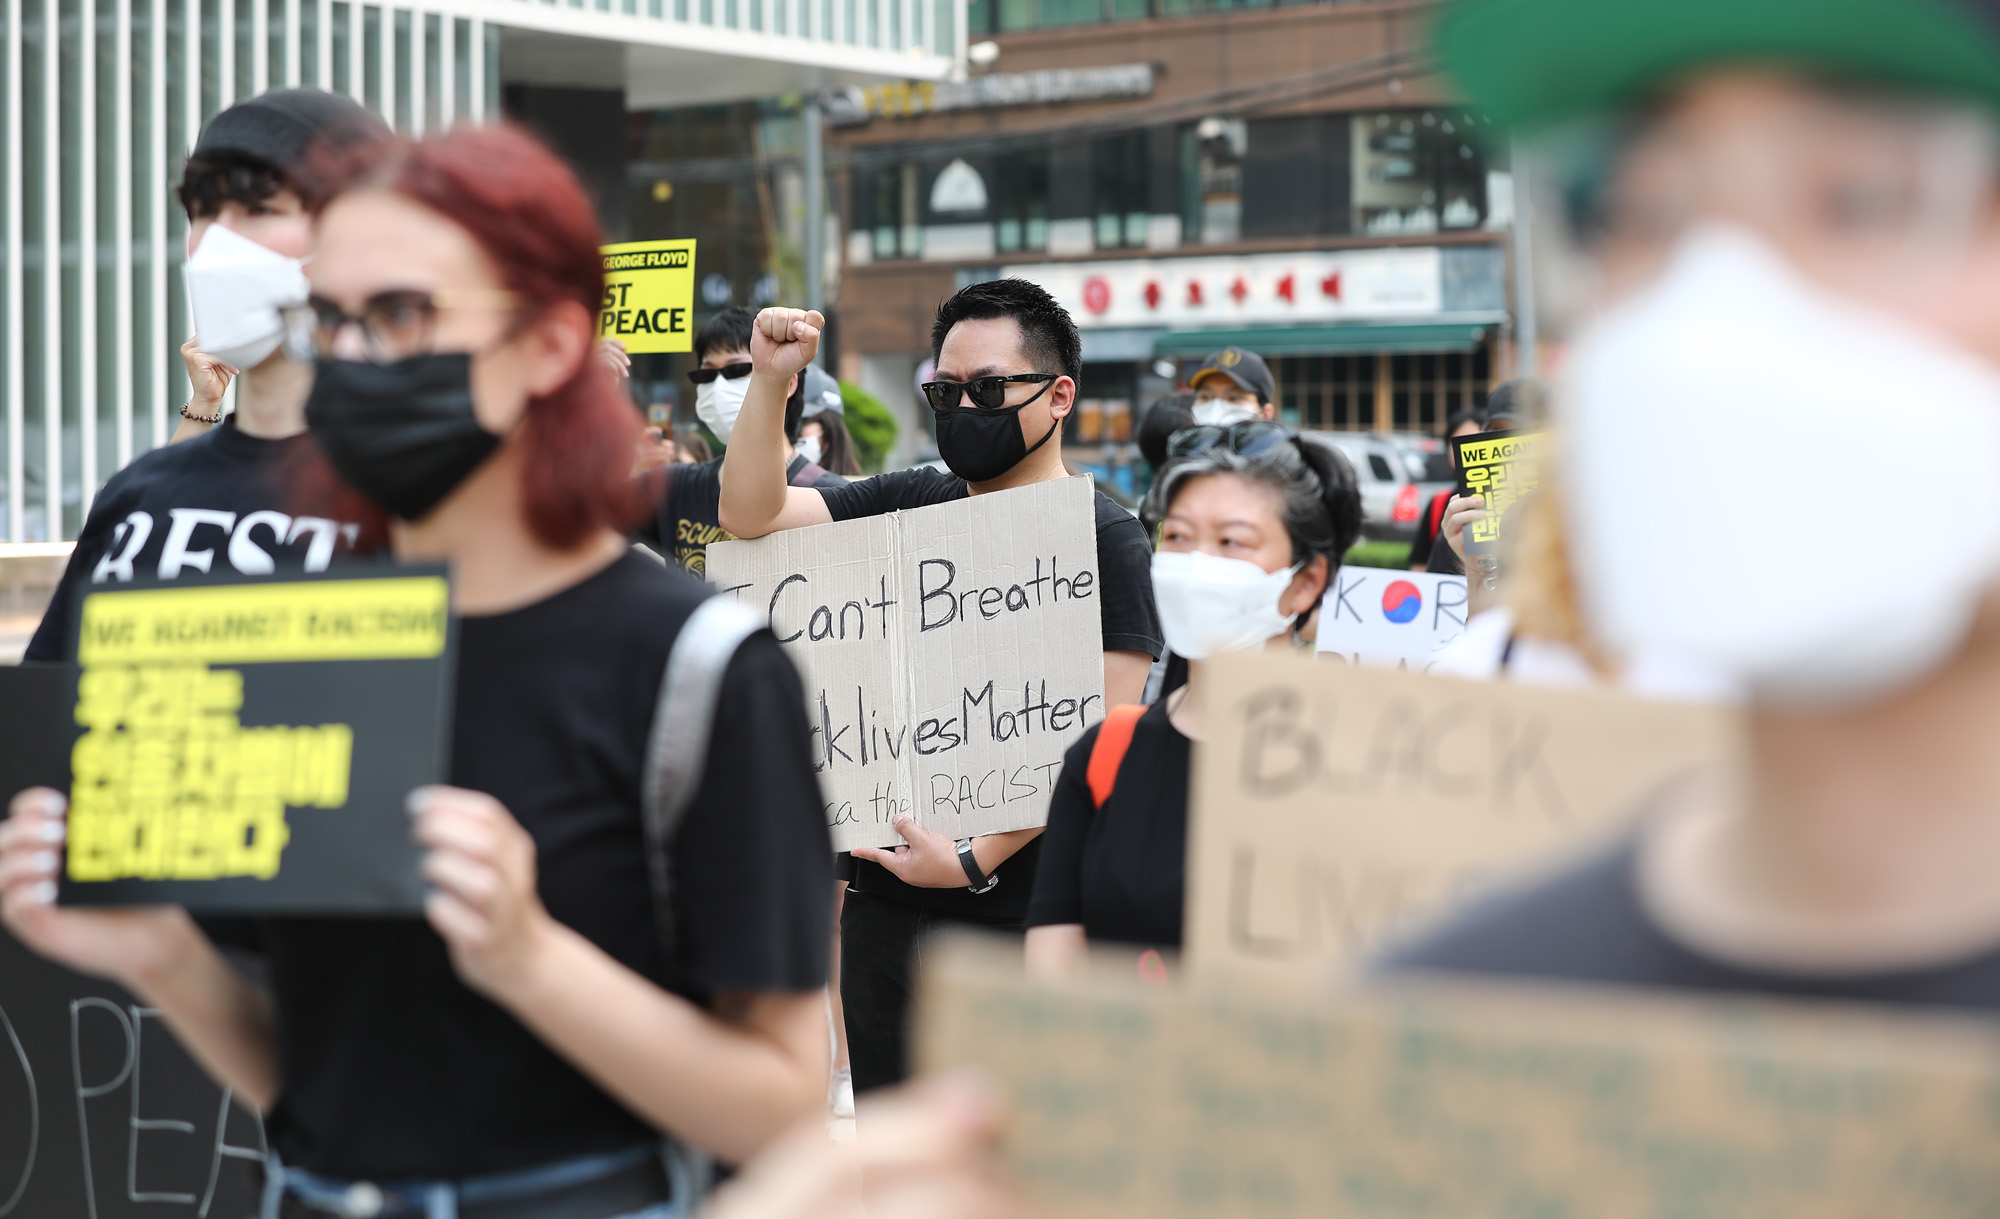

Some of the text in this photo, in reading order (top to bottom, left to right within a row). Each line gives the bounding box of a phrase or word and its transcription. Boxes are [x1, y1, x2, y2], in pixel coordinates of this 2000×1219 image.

[603, 251, 687, 269] GEORGE FLOYD
[601, 308, 685, 335] PEACE
[1463, 448, 1488, 463] WE
[919, 555, 1094, 633] Breathe
